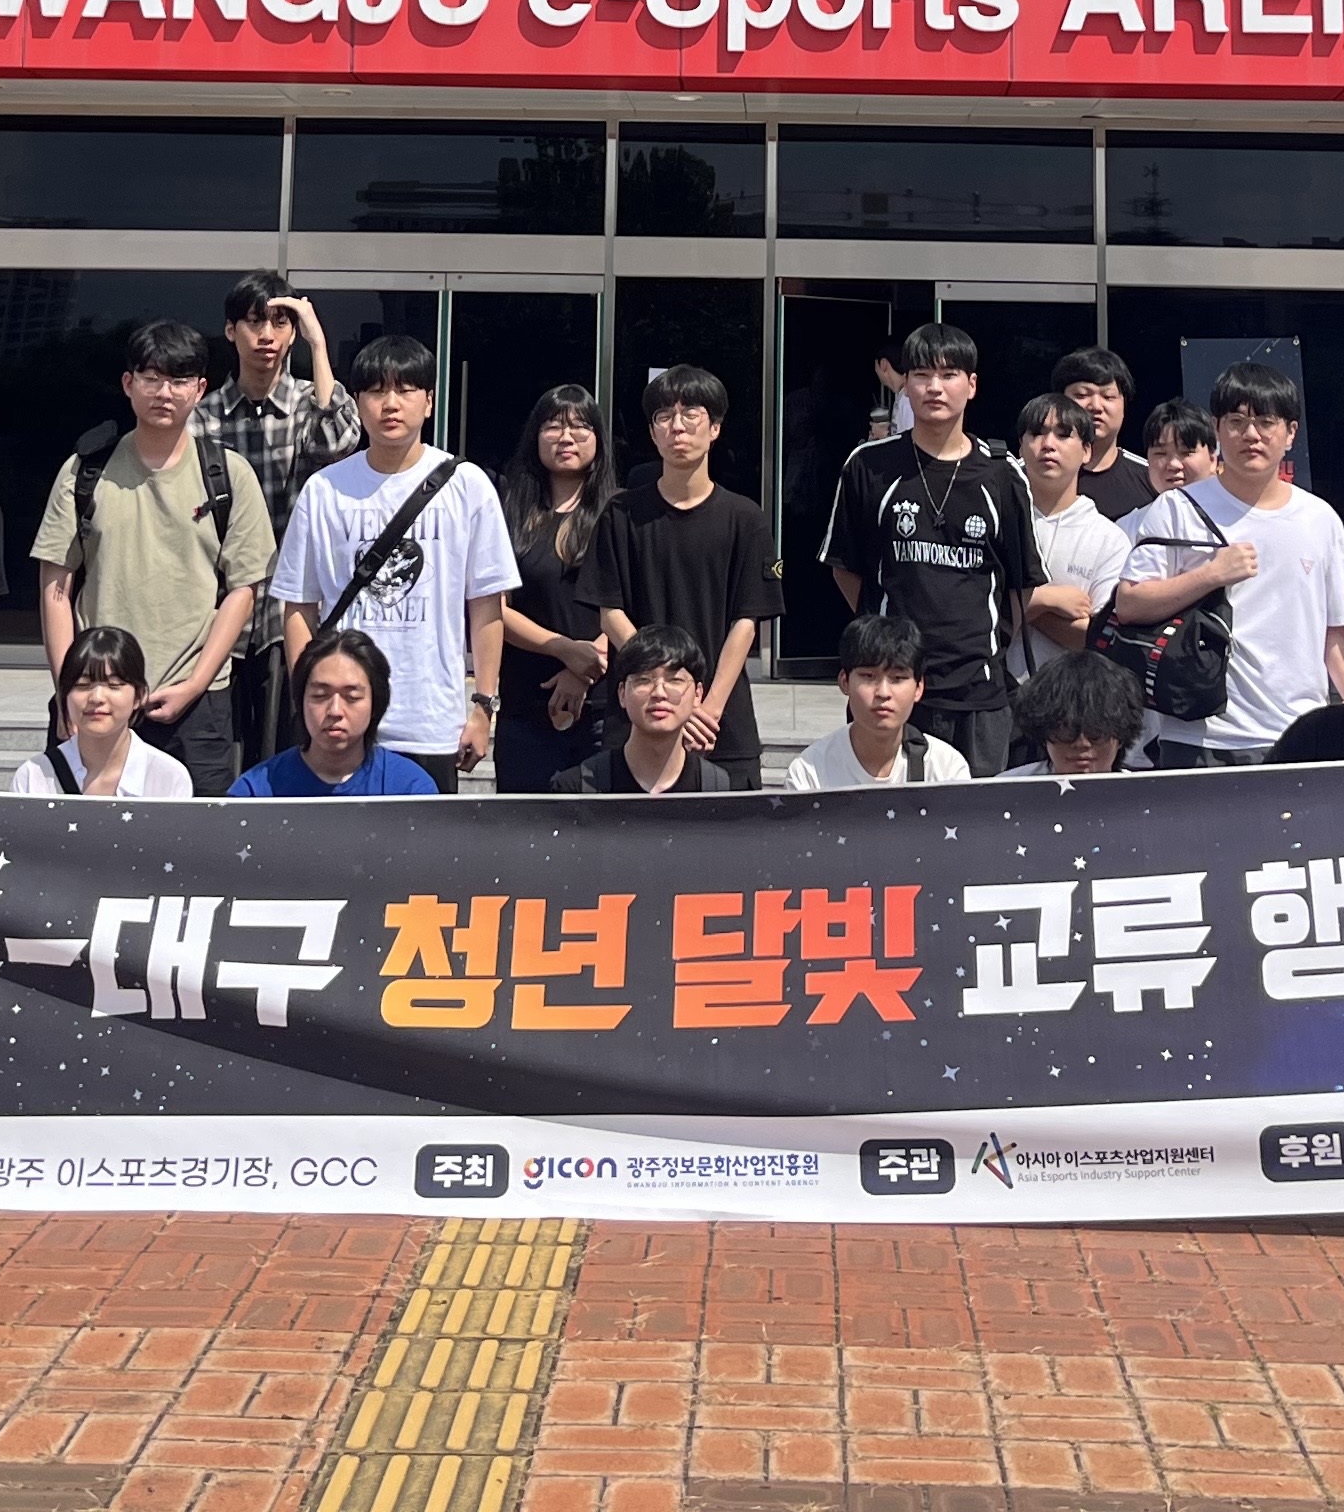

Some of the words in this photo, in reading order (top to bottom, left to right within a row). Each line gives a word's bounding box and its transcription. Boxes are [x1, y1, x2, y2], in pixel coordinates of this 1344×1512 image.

[892, 540, 984, 568] VANNWORKSCLUB
[378, 894, 637, 1030] 청년
[672, 884, 924, 1028] 달빛
[962, 871, 1218, 1015] 교류
[626, 1154, 819, 1178] 광주정보문화산업진흥원
[878, 1147, 941, 1183] 주관
[1016, 1151, 1061, 1169] 아시아
[1064, 1146, 1215, 1168] 이스포츠산업지원센터
[1279, 1132, 1343, 1168] 후원
[56, 1156, 278, 1190] 이스포츠경기장,
[290, 1157, 378, 1187] GCC
[432, 1154, 494, 1187] 주최
[1017, 1172, 1039, 1182] Asia
[1040, 1170, 1078, 1183] Esports
[1080, 1168, 1122, 1182] Industry
[1124, 1167, 1165, 1180] Support
[1167, 1166, 1202, 1177] Center
